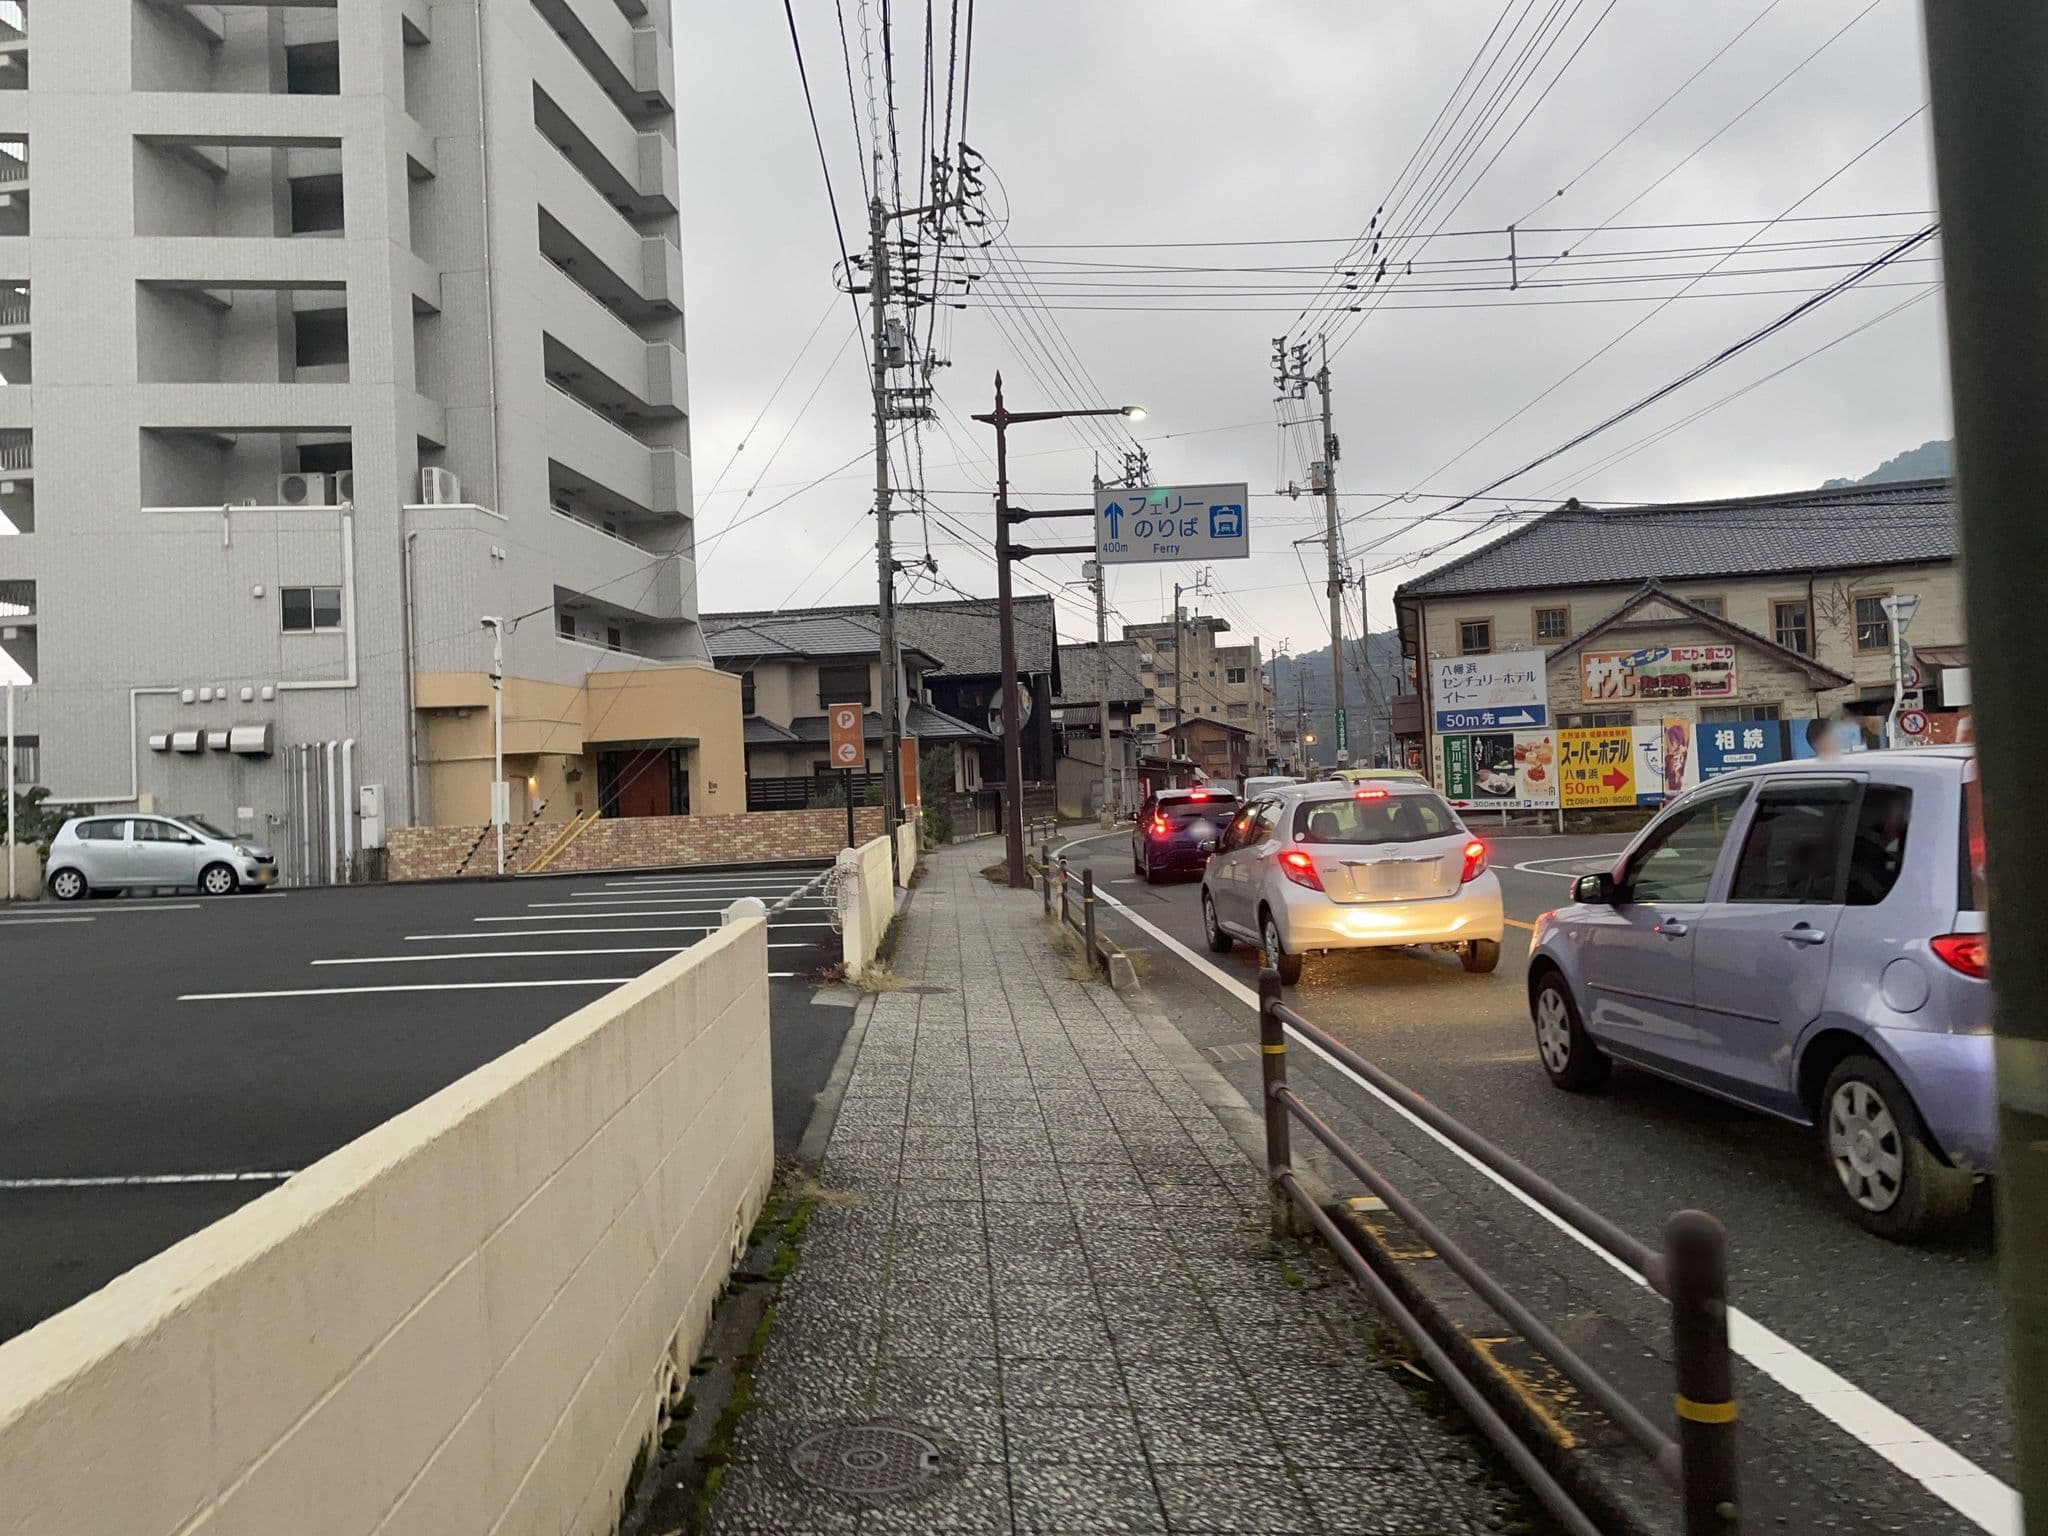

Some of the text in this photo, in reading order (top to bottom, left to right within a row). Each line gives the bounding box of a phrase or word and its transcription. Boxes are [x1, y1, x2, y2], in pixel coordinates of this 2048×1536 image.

[1129, 495, 1204, 516] フェリー
[1134, 517, 1199, 538] のりば
[1103, 542, 1128, 553] 400m
[1153, 543, 1180, 555] Ferry
[1627, 650, 1666, 665] オーダー
[1442, 663, 1477, 676] 八幡浜
[1586, 656, 1635, 698] 枕
[1442, 671, 1536, 689] センチュリーホテル
[1442, 691, 1478, 704] イトー
[1714, 728, 1764, 751] 相続
[1561, 739, 1630, 766] スーパーホテル
[1565, 768, 1599, 781] 八幡浜
[1565, 782, 1600, 795] 50m
